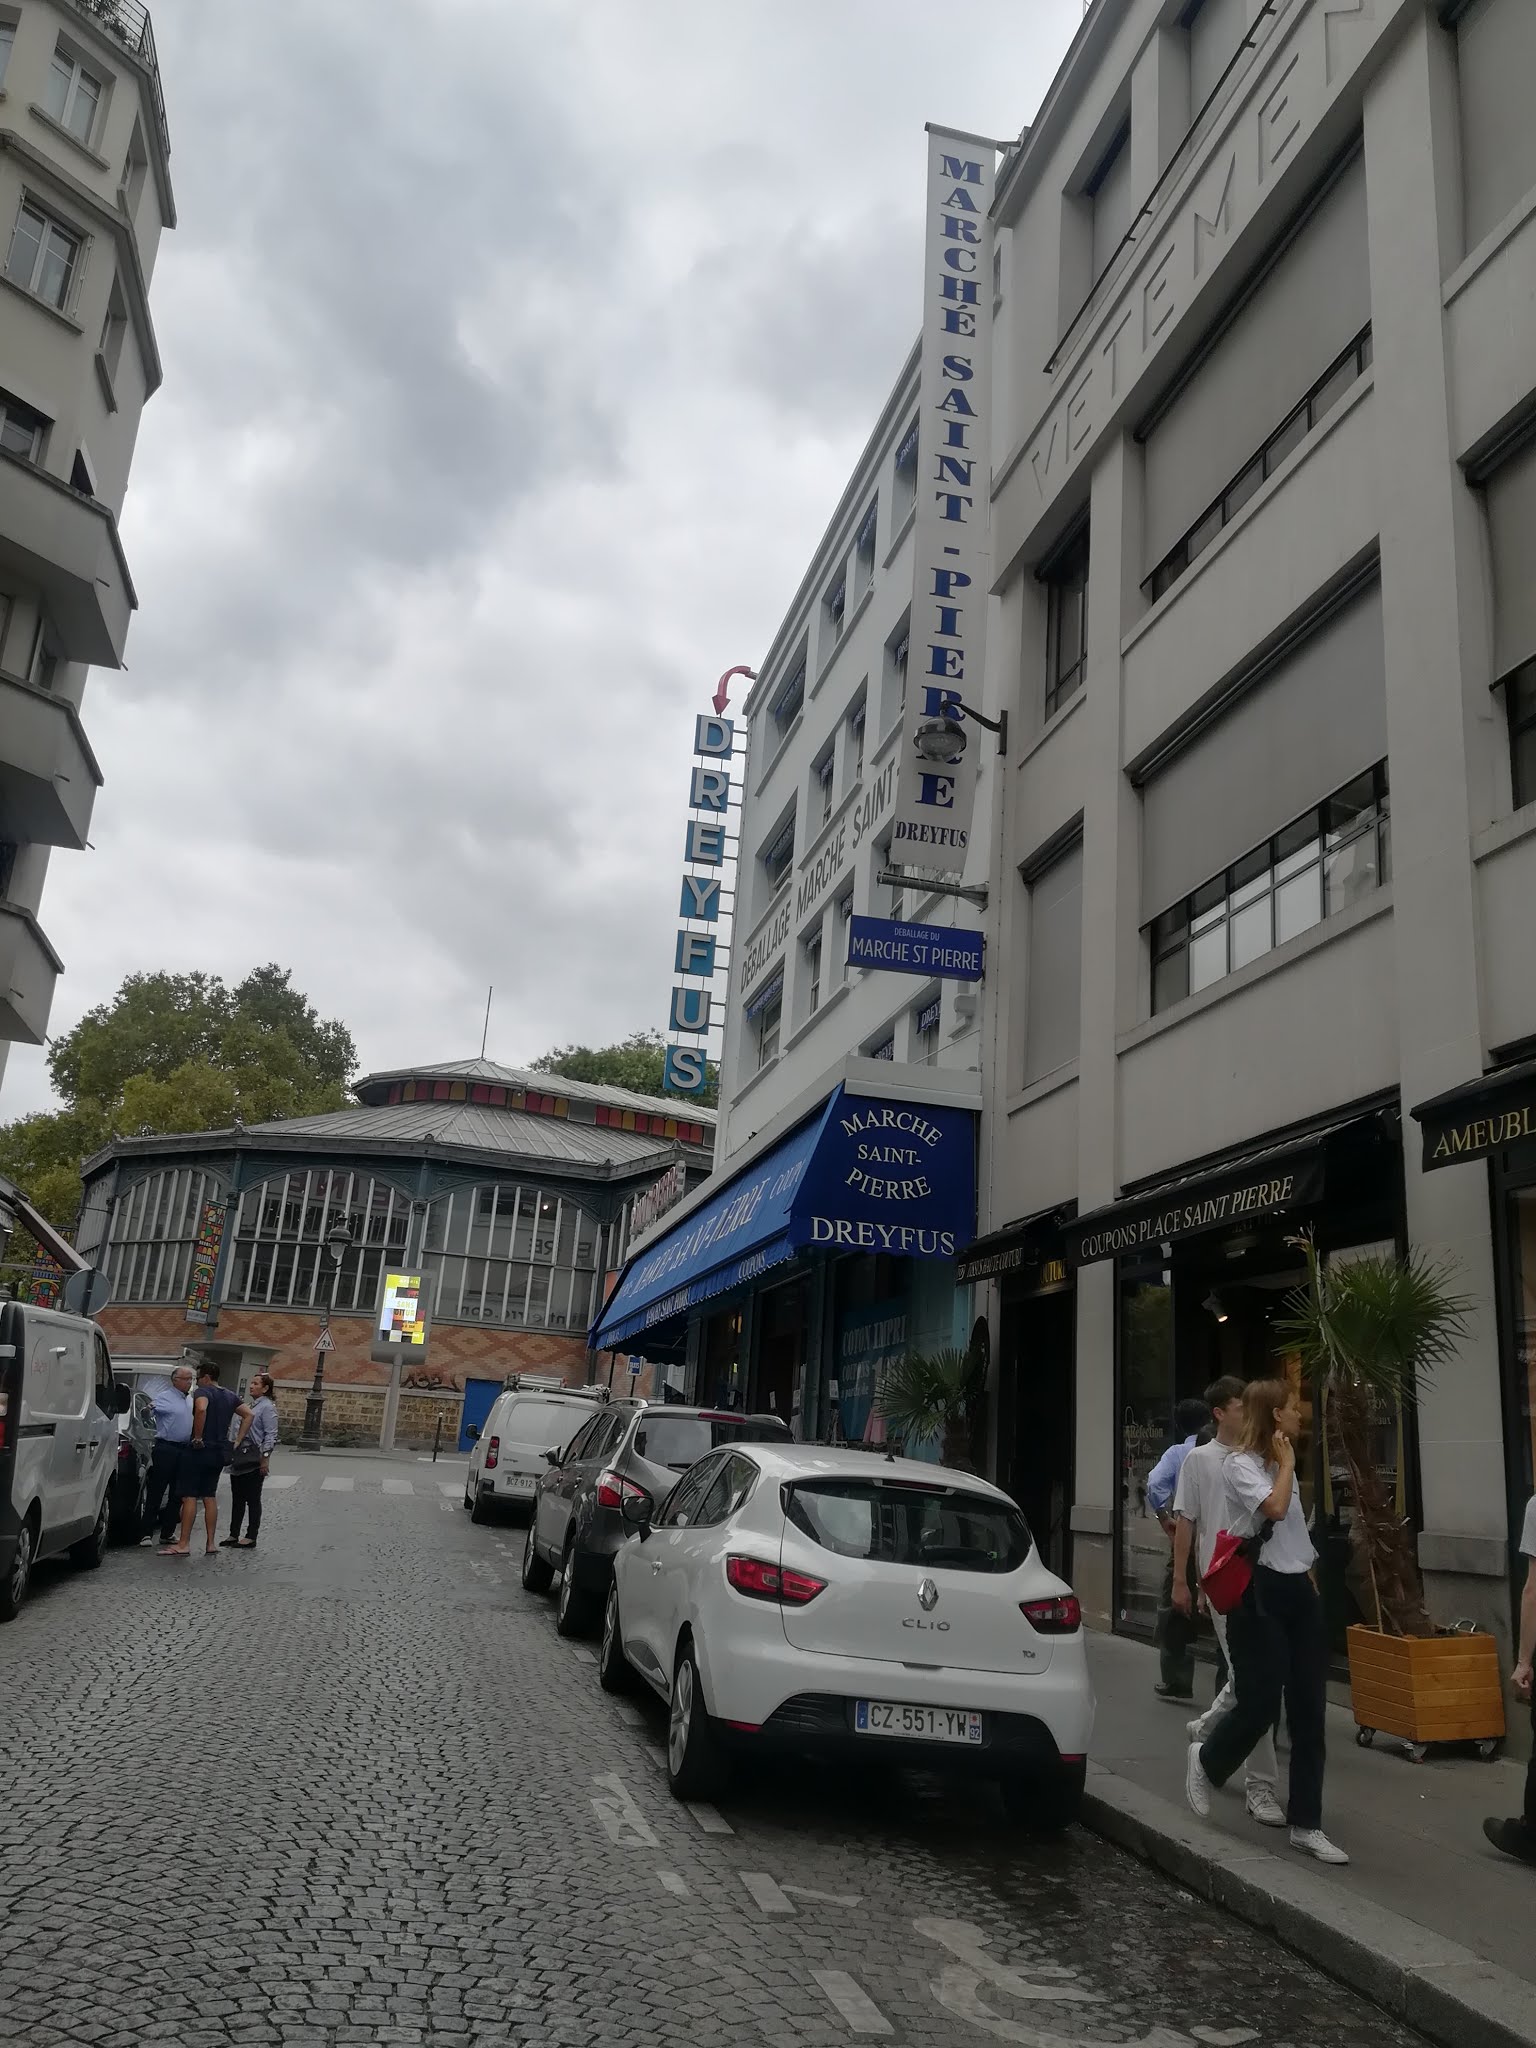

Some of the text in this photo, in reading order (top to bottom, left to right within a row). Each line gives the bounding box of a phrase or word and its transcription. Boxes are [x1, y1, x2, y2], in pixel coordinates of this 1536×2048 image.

[914, 153, 985, 809] MARCHÉ SAINT-PIERE
[893, 820, 969, 850] DREYFUS
[668, 716, 732, 1089] DREYFUS
[852, 936, 980, 972] MARCHE ST PIERRE
[930, 931, 940, 942] DU
[839, 1108, 944, 1148] MARCHE
[1431, 1106, 1536, 1159] AMEUBL
[857, 1143, 923, 1166] SAINT-
[844, 1166, 932, 1201] PIERRE
[1080, 1222, 1138, 1259] COUPONS
[1138, 1209, 1181, 1243] PLACE
[1182, 1194, 1231, 1229] SAINT
[1230, 1175, 1295, 1216] PIERRE
[810, 1216, 956, 1257] DREYFUS
[901, 1616, 951, 1632] CLIO
[870, 1704, 967, 1737] CZ-551-YW
[969, 1726, 981, 1740] 92
